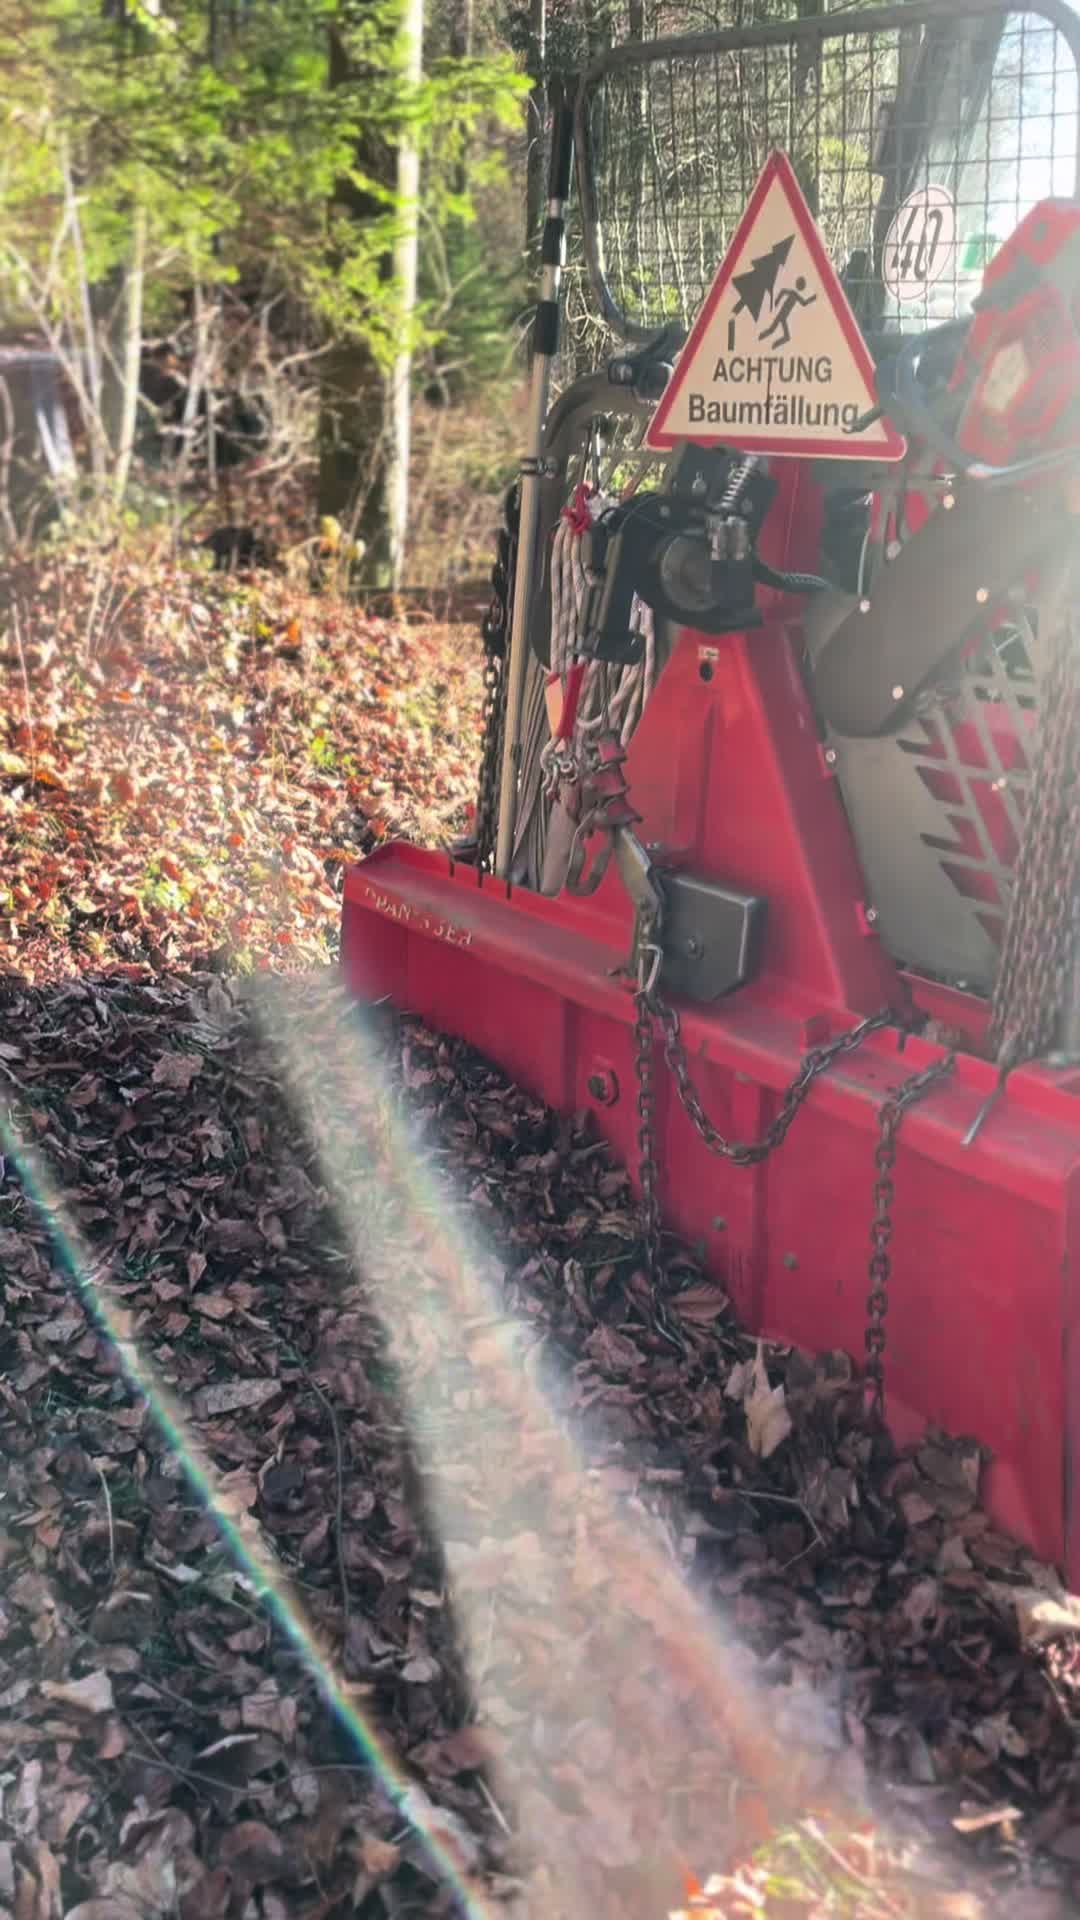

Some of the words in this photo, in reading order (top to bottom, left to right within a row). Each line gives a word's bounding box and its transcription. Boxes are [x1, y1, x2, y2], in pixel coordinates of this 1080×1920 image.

[890, 206, 944, 280] 40
[712, 356, 833, 384] ACHTUNG
[688, 393, 859, 434] Baumfällung
